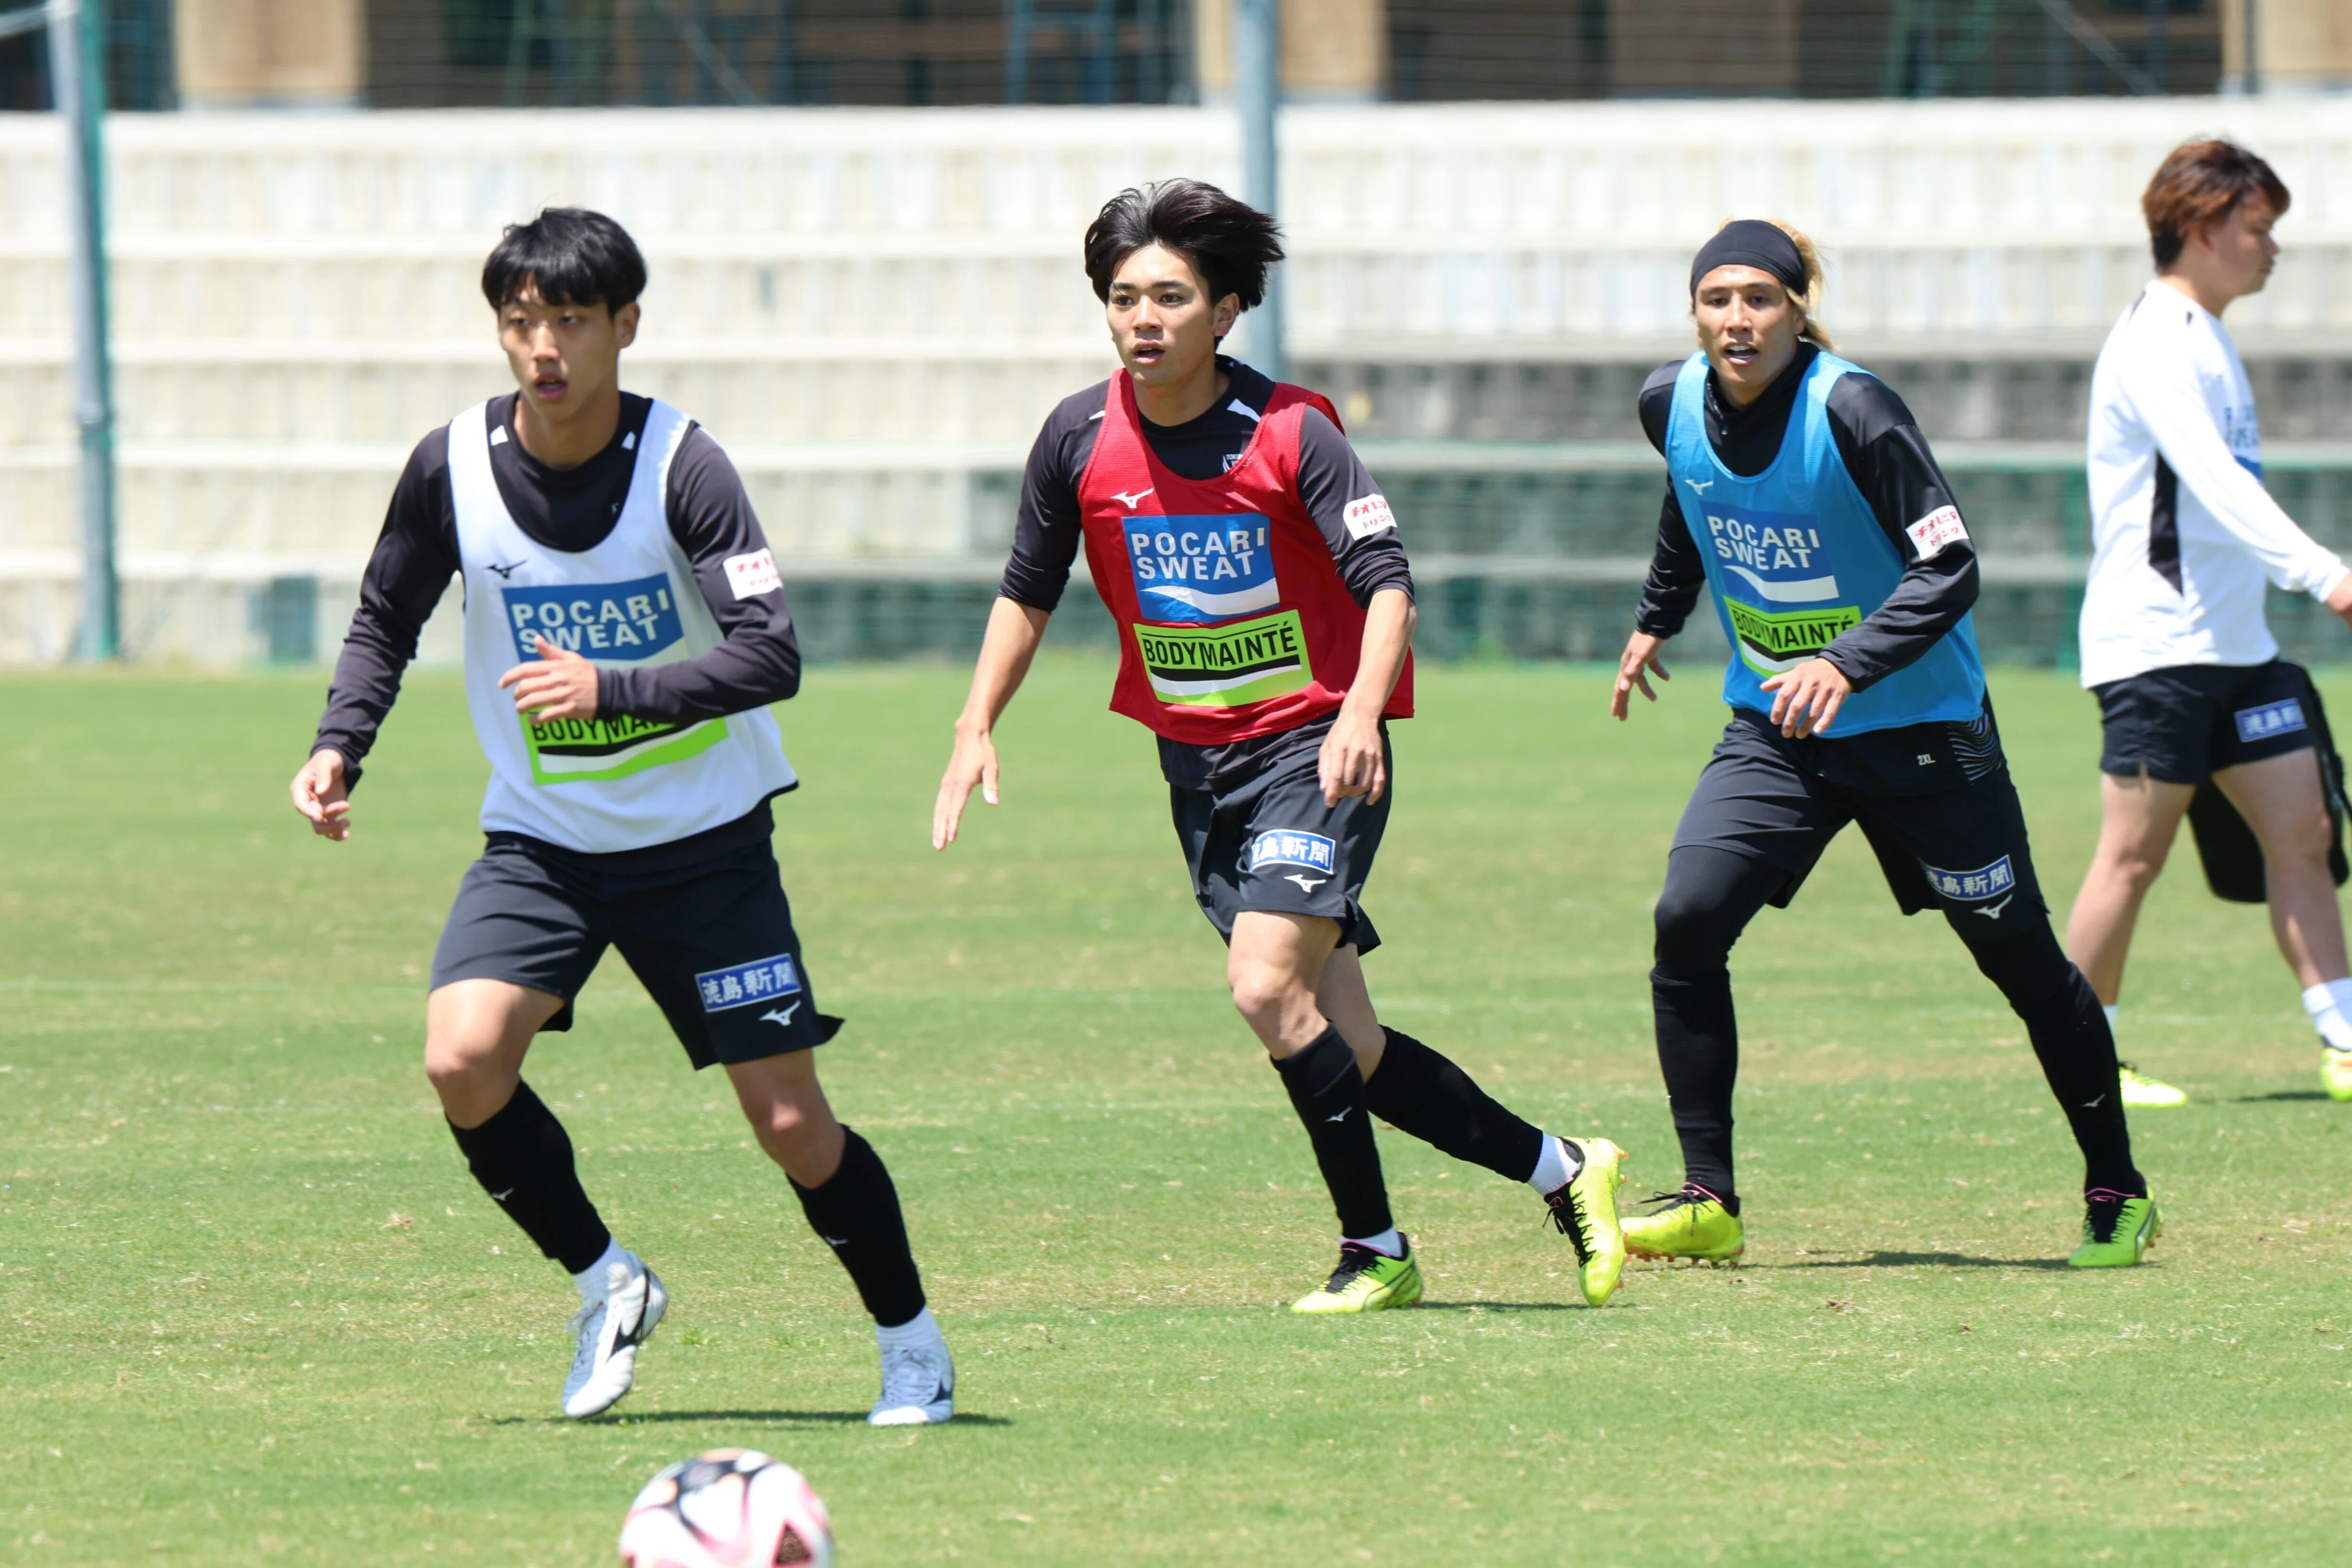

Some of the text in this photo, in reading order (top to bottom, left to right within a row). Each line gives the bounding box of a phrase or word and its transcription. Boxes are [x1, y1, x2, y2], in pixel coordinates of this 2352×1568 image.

[1131, 528, 1264, 555] POCARI
[1707, 515, 1820, 548] POCARI
[1137, 551, 1254, 580] SWEAT
[1715, 537, 1811, 570] SWEAT
[511, 588, 669, 628] POCARI
[518, 614, 659, 653] SWEAT
[1142, 621, 1297, 670] BODYMAINTÉ
[1252, 836, 1330, 867] 島新聞
